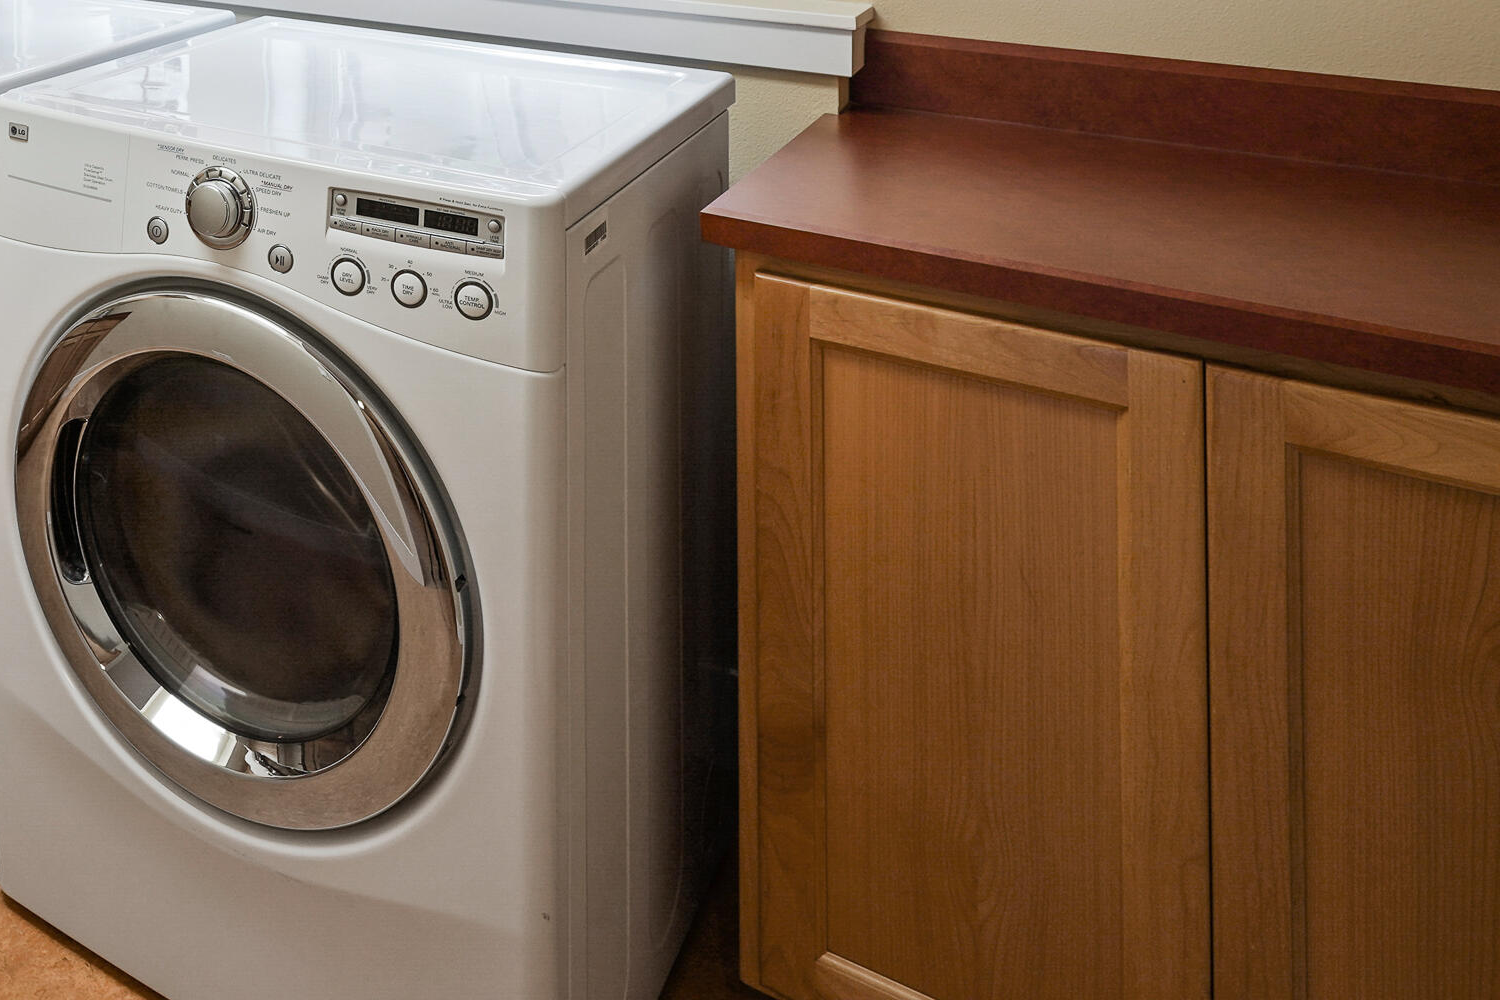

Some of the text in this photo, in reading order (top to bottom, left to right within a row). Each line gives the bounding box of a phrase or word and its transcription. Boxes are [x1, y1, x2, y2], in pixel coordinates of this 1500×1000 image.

[212, 154, 236, 165] DELICATES
[171, 169, 189, 177] NORMAL
[243, 169, 282, 181] ULTRA DELICATE
[255, 187, 271, 195] SPEED
[260, 206, 283, 216] FRESHEN
[464, 269, 484, 277] MEDIUM
[459, 300, 485, 309] CONTROL
